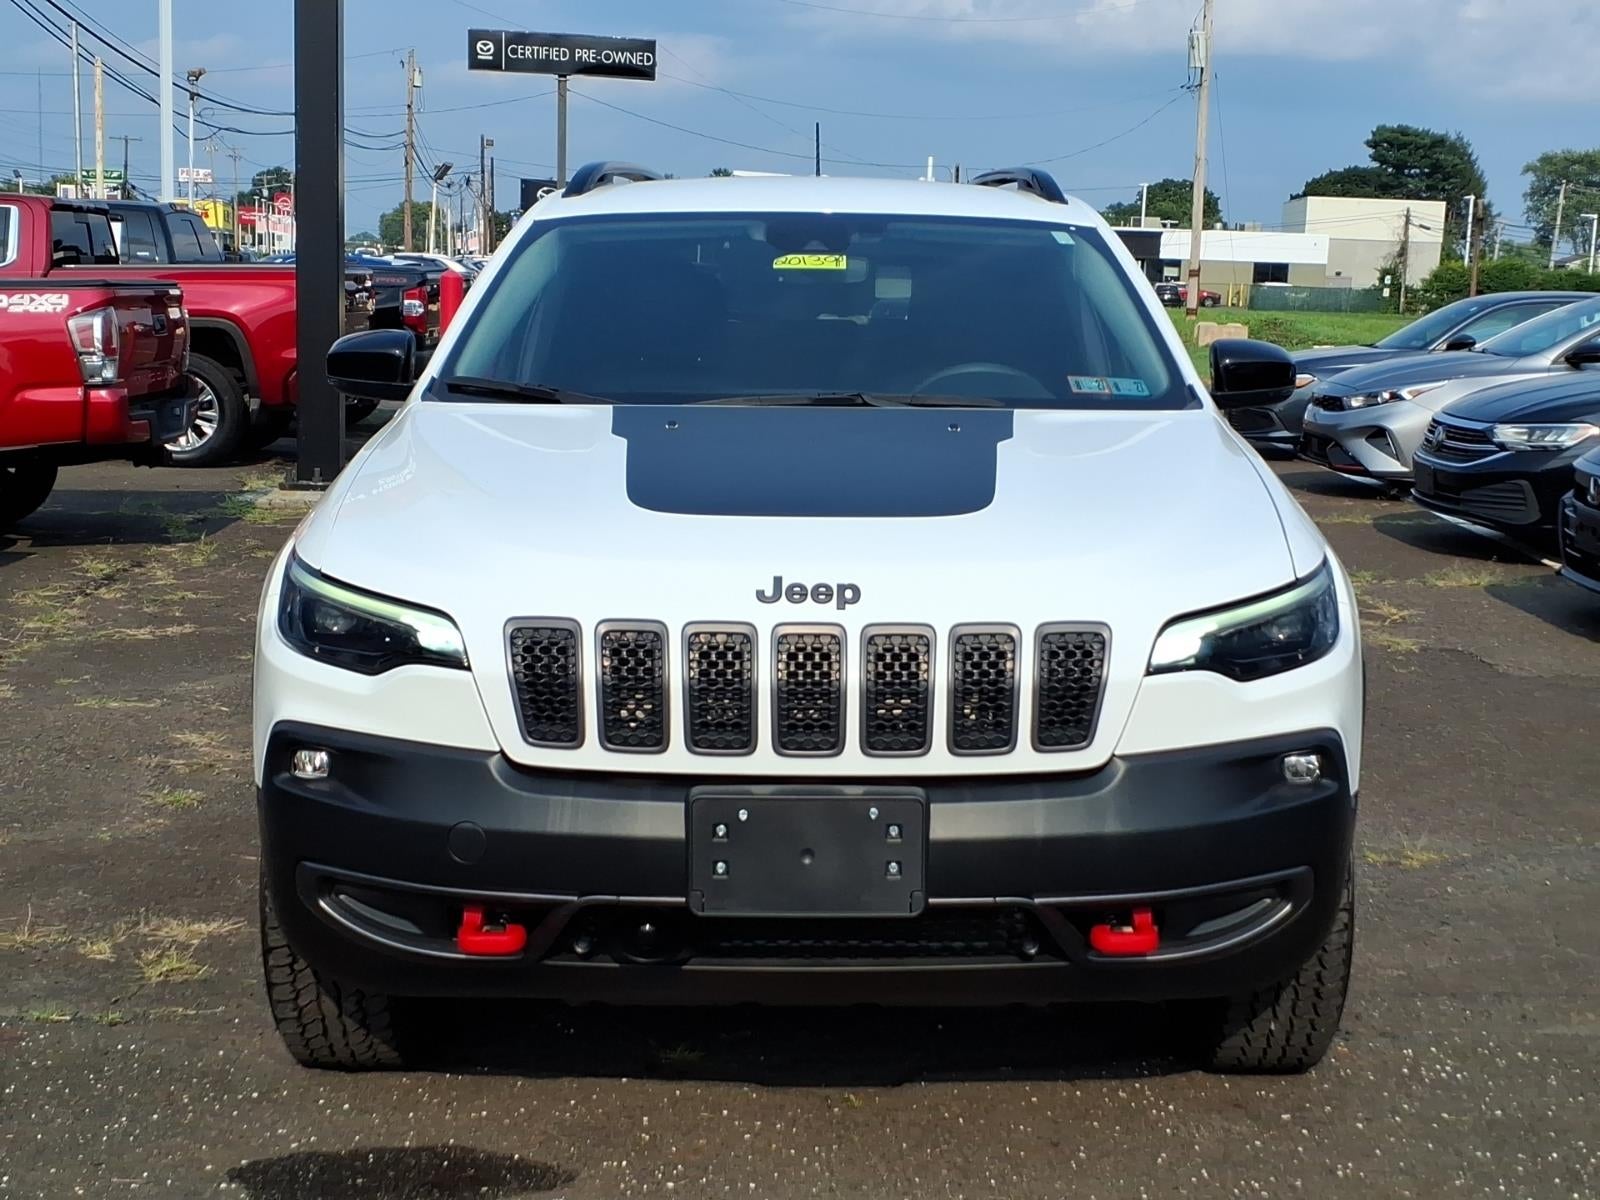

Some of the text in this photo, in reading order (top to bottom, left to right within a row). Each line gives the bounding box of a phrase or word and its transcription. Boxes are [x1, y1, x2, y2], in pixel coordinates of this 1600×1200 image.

[507, 44, 653, 66] CERTIFIED PRE-OWNED
[7, 304, 66, 313] SPORT
[756, 575, 861, 610] Jeep
